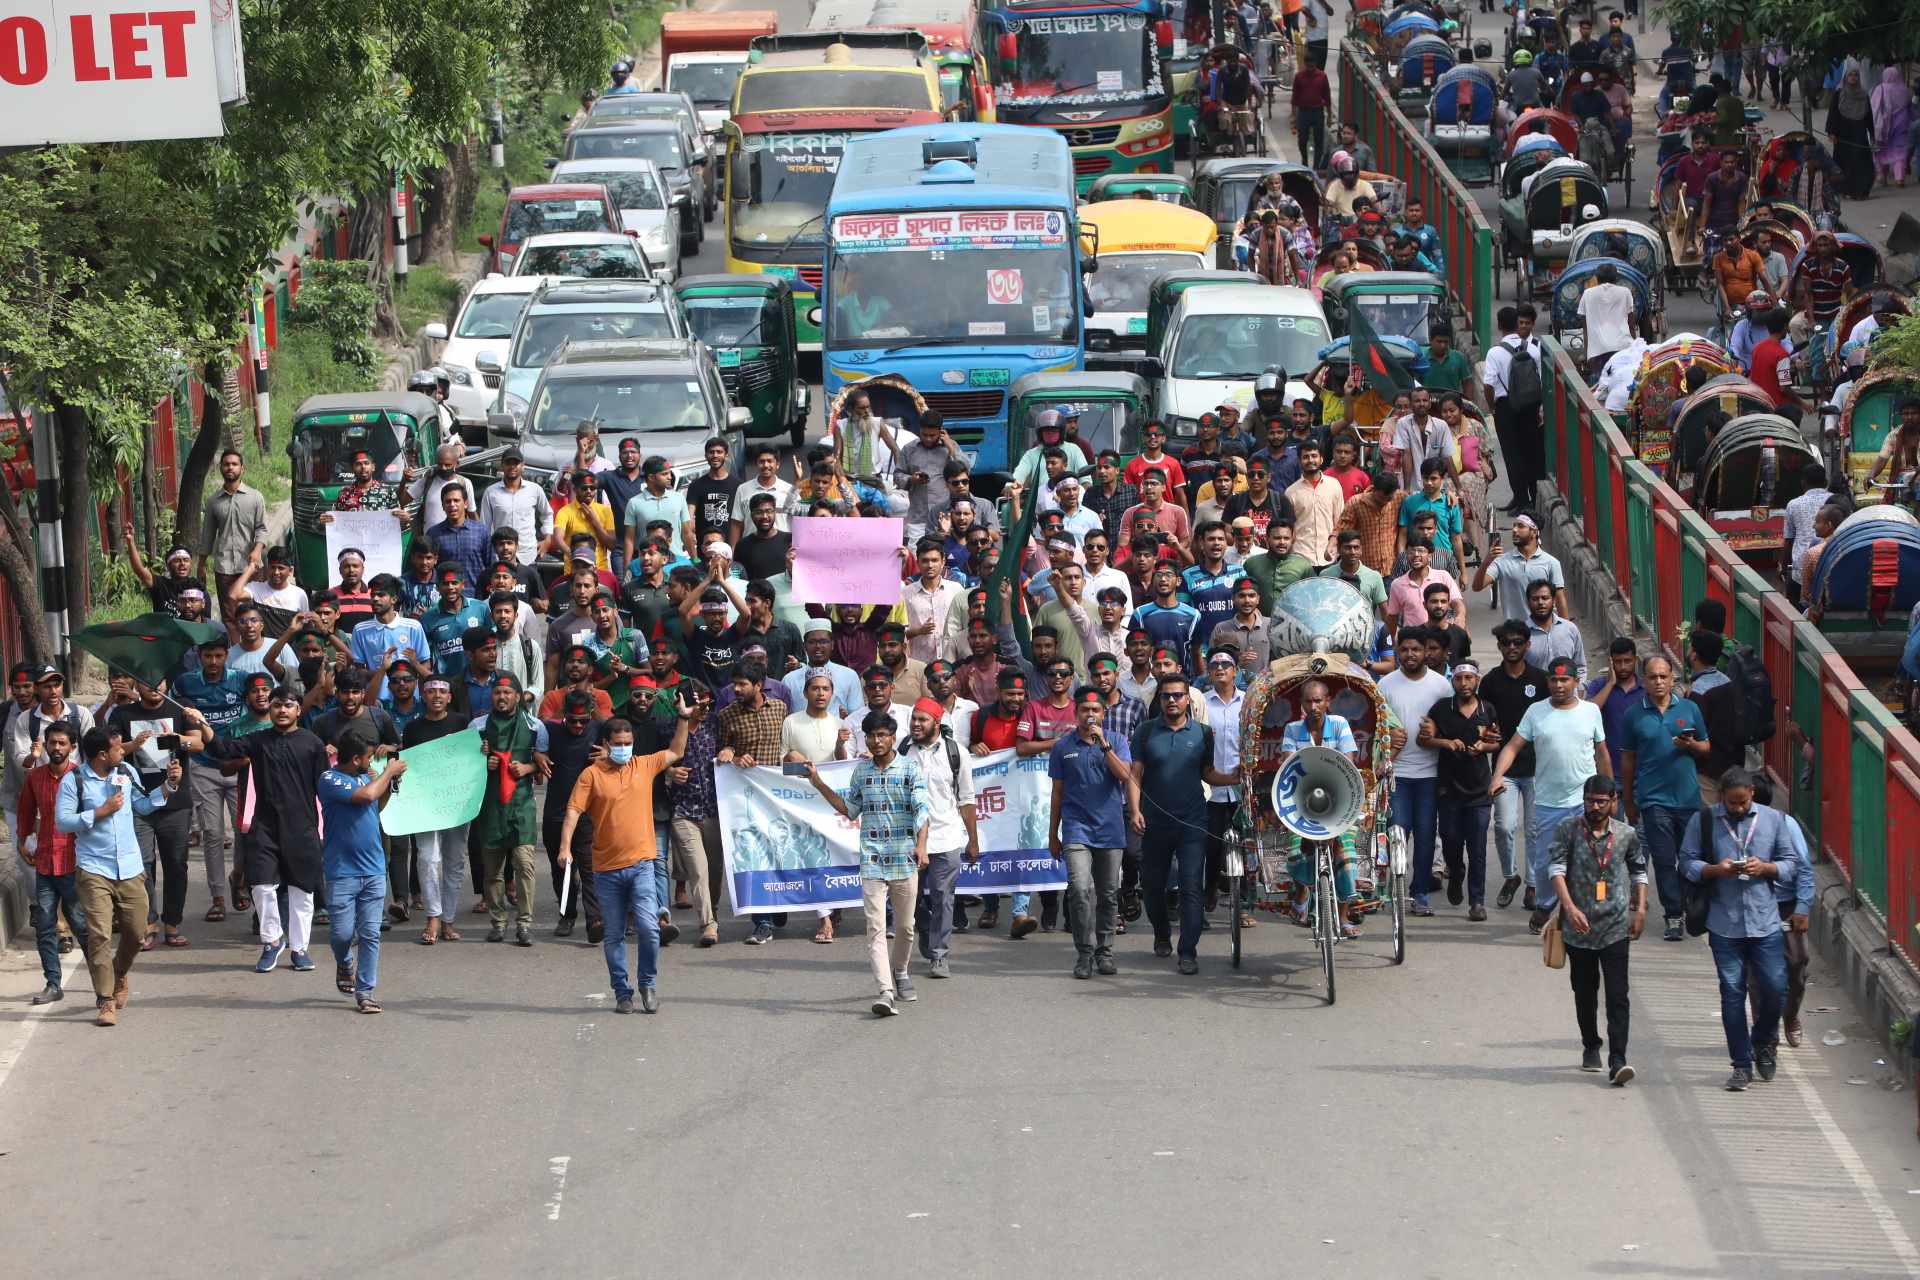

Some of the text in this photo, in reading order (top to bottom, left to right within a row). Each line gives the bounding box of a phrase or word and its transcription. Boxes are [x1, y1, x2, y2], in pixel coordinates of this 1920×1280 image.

[71, 10, 195, 82] LET
[839, 212, 1045, 238] মিরপুর সুপার লিংক লিঃ
[990, 272, 1019, 301] ৩৬
[203, 705, 241, 720] CIOLOGY
[771, 786, 818, 801] ২০১৮
[989, 860, 1012, 873] ঢাকা
[762, 880, 805, 893] আয়োজনে
